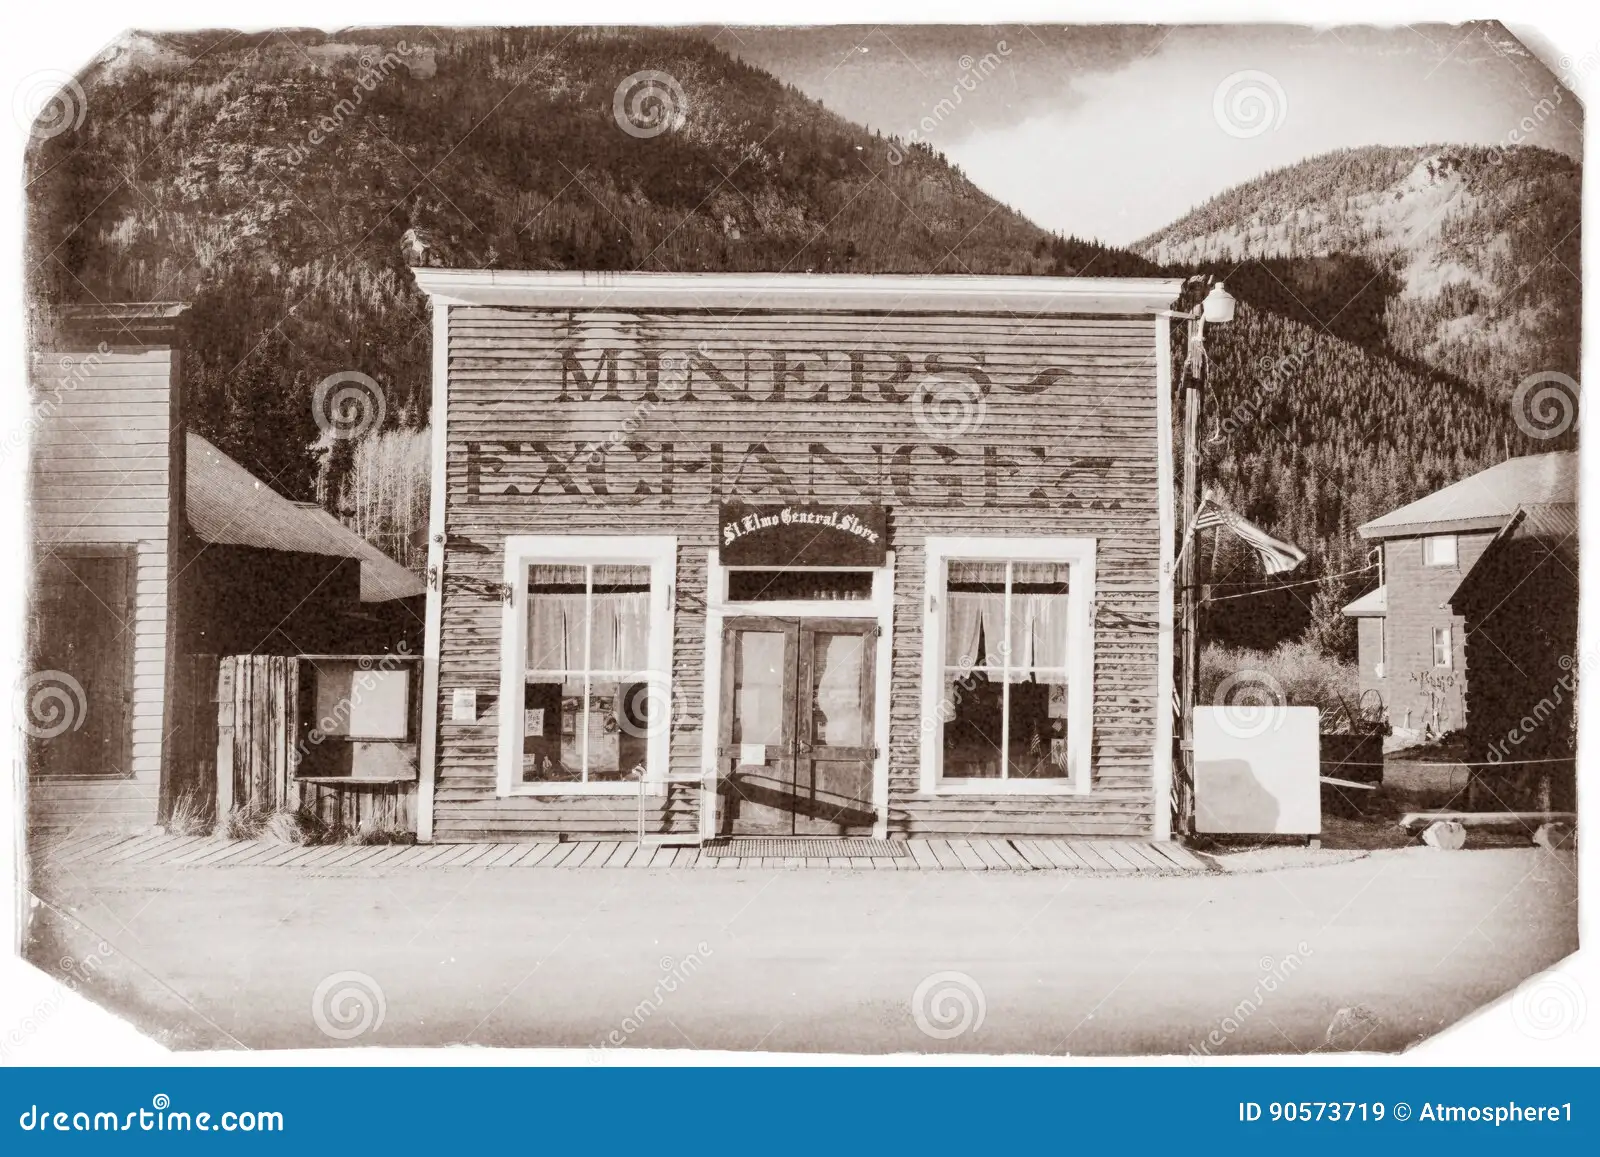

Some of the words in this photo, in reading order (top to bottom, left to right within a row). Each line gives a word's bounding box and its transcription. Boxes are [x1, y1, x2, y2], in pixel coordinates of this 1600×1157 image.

[552, 347, 992, 403] MINERS
[460, 440, 1048, 508] EXCHANGE
[741, 512, 780, 536] Elmo
[780, 506, 839, 527] General
[836, 513, 880, 544] Store
